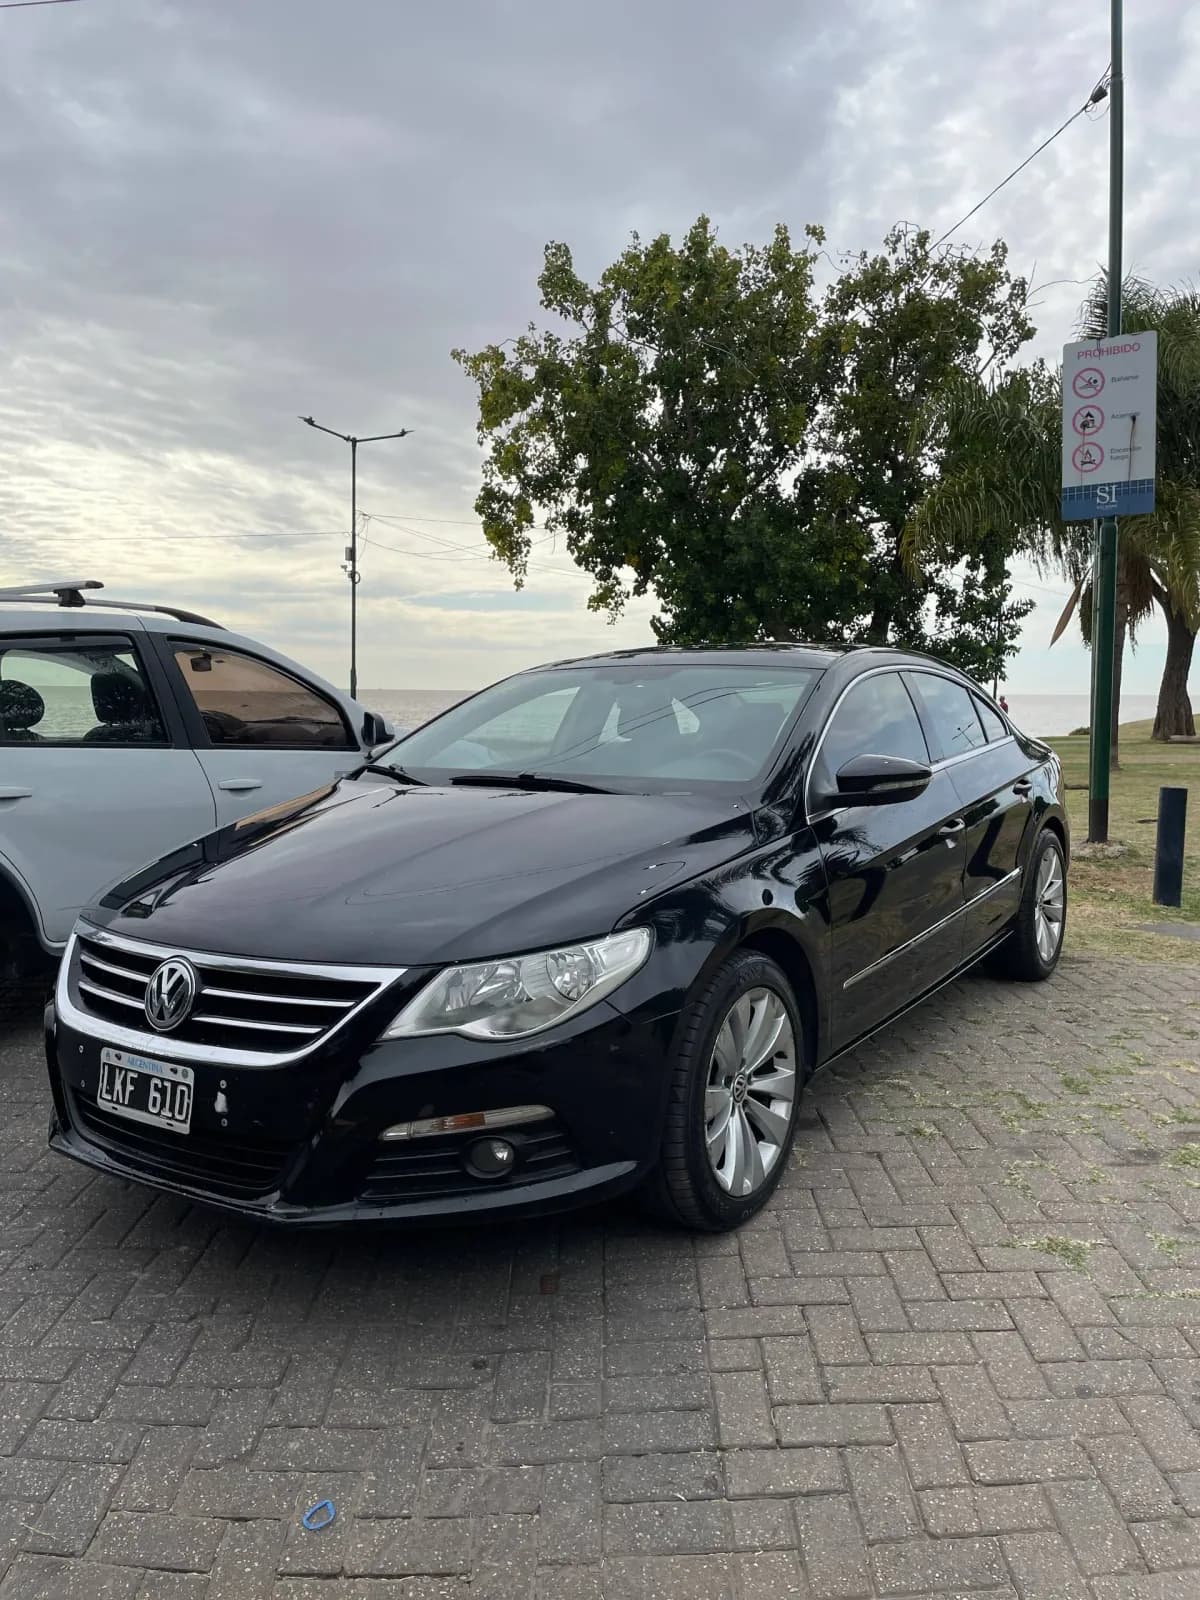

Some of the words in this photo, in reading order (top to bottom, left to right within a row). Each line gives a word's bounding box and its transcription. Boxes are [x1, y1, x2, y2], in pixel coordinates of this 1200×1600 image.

[1077, 342, 1141, 360] PROHIBIDO
[1096, 484, 1118, 504] SI
[147, 958, 195, 1030] VW
[101, 1064, 138, 1105] LKF
[148, 1077, 188, 1121] 610
